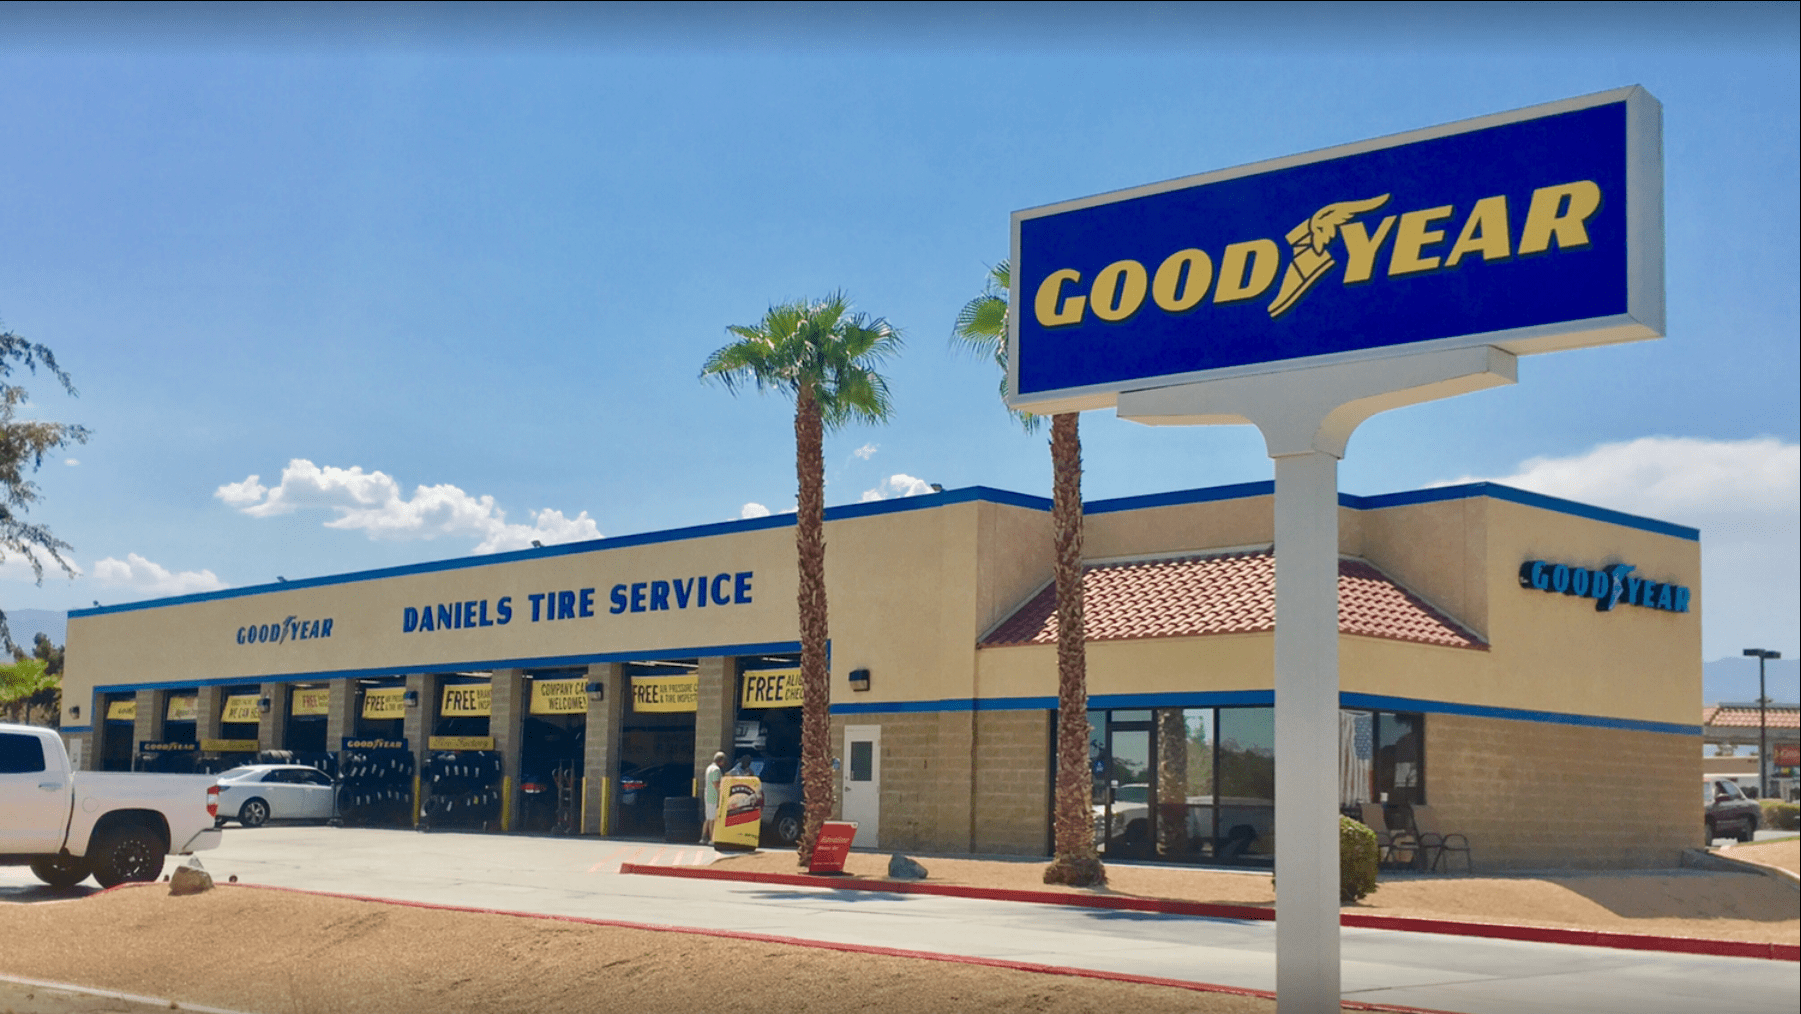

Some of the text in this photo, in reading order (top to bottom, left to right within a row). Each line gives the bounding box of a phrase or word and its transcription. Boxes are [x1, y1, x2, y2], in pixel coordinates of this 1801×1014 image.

[1034, 179, 1601, 328] GOODYEAR
[1527, 560, 1691, 614] GOODYEAR
[402, 571, 754, 633] DANIELS TIRE SERVICE
[236, 616, 334, 645] GOODYEAR
[445, 690, 477, 710] FREE
[632, 684, 659, 704] FREE
[746, 675, 786, 702] FREE
[365, 695, 385, 711] FREE
